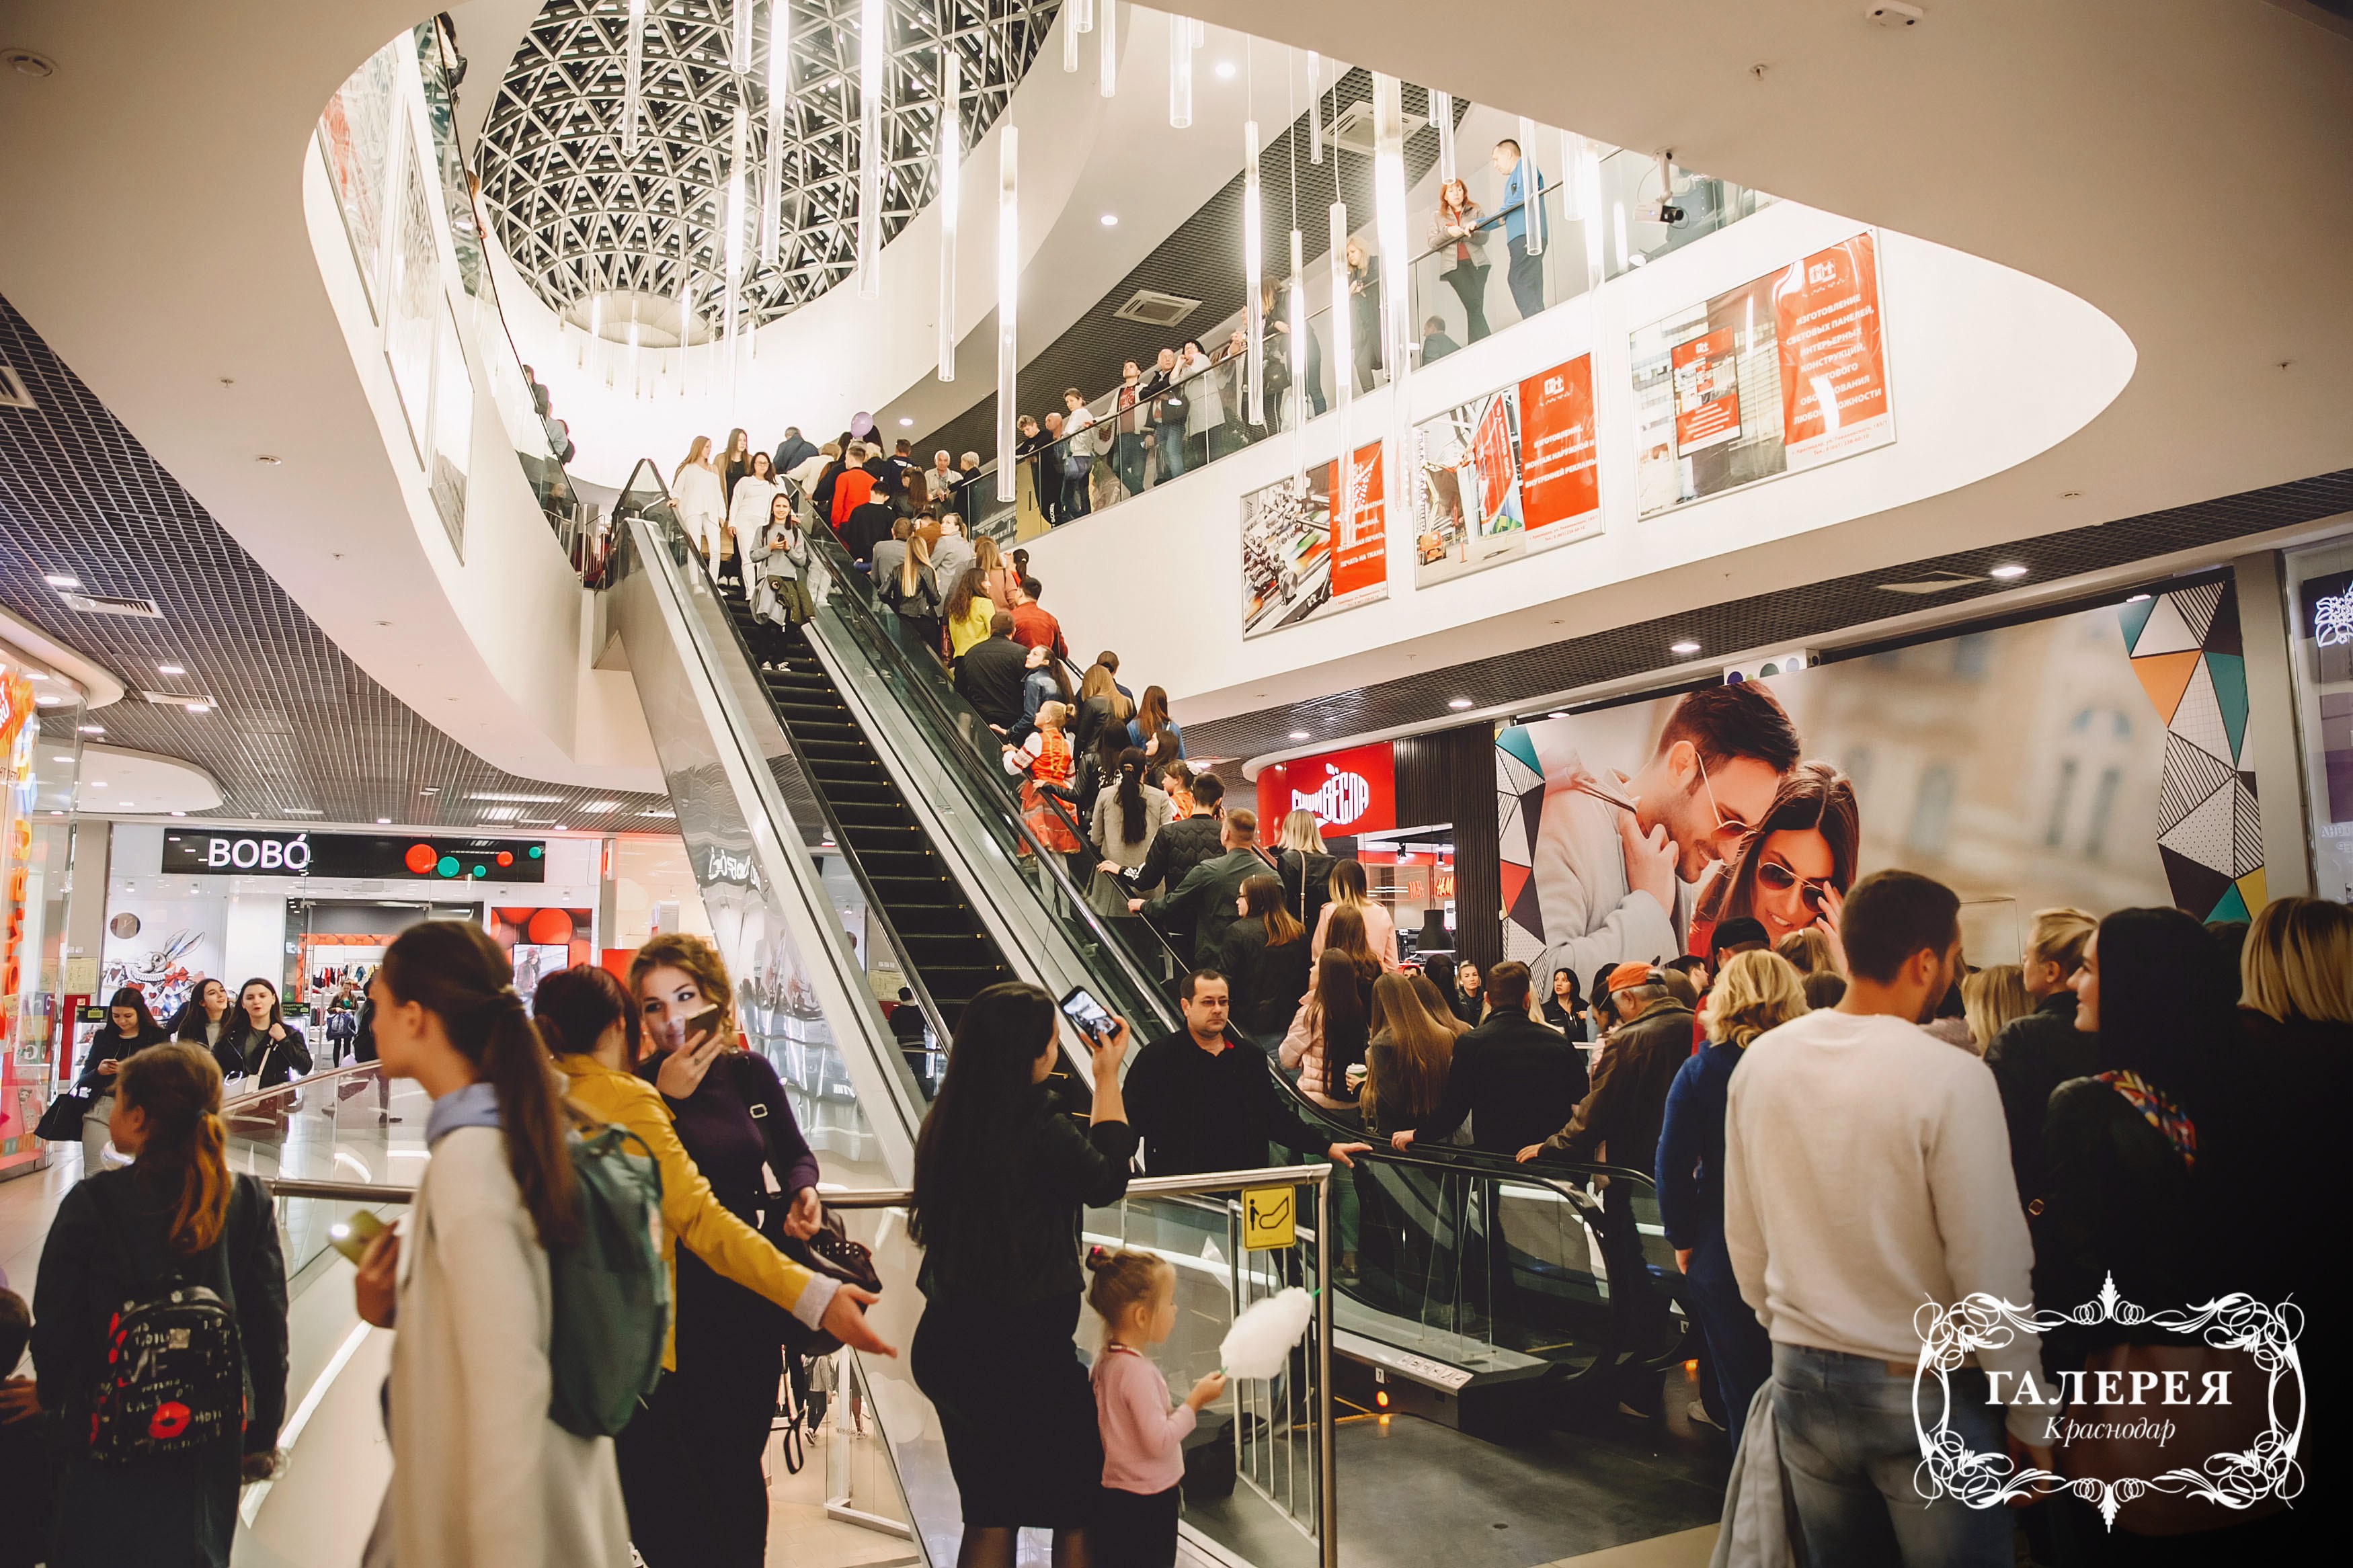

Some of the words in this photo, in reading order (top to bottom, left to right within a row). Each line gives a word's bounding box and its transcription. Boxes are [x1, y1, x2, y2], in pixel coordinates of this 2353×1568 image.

[1796, 293, 1861, 325] ИЗГОТОВЛЕНИЕ
[1786, 322, 1831, 345] СВЕТОВЫХ
[1831, 304, 1874, 329] ПАНЕЛЕЙ,
[1800, 327, 1862, 357] ИНТЕРЬЕРНЫХ
[1800, 343, 1866, 373] КОНСТРУКЦИЙ,
[1800, 375, 1870, 405] ОБООВАНИЯ
[1524, 454, 1552, 470] МОНТАЖ
[1552, 440, 1589, 460] НАРУЖНОЙ
[1589, 438, 1595, 446] И
[1525, 468, 1564, 489] ВНУТРЕННЕЙ
[1564, 458, 1597, 474] РЕКЛАМЫ
[1340, 556, 1359, 567] ПЕЧАТЬ
[1359, 554, 1367, 562] НА
[1366, 548, 1385, 559] ТКАНИ
[1435, 876, 1454, 897] H&M
